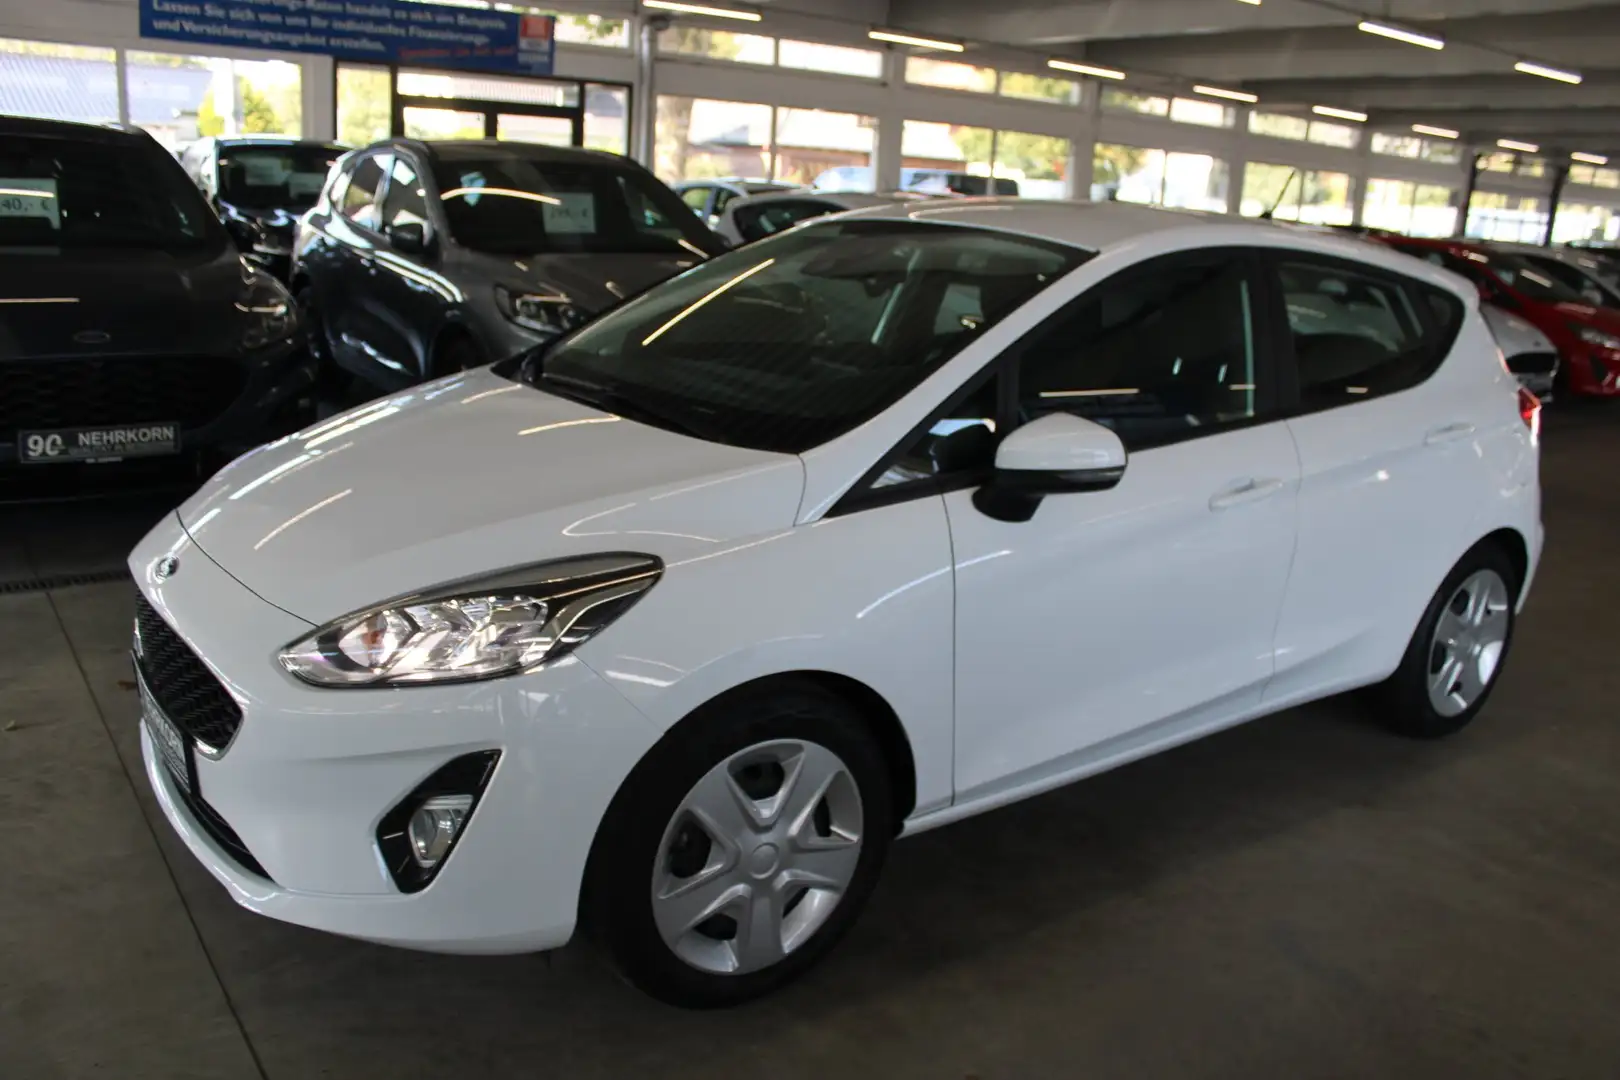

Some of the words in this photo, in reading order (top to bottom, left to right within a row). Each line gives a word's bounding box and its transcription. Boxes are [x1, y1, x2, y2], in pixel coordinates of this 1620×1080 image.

[153, 0, 200, 15] Lassen
[204, 3, 226, 18] Sie
[229, 8, 255, 21] sich
[153, 20, 180, 33] und
[77, 426, 174, 446] NEHRKORN
